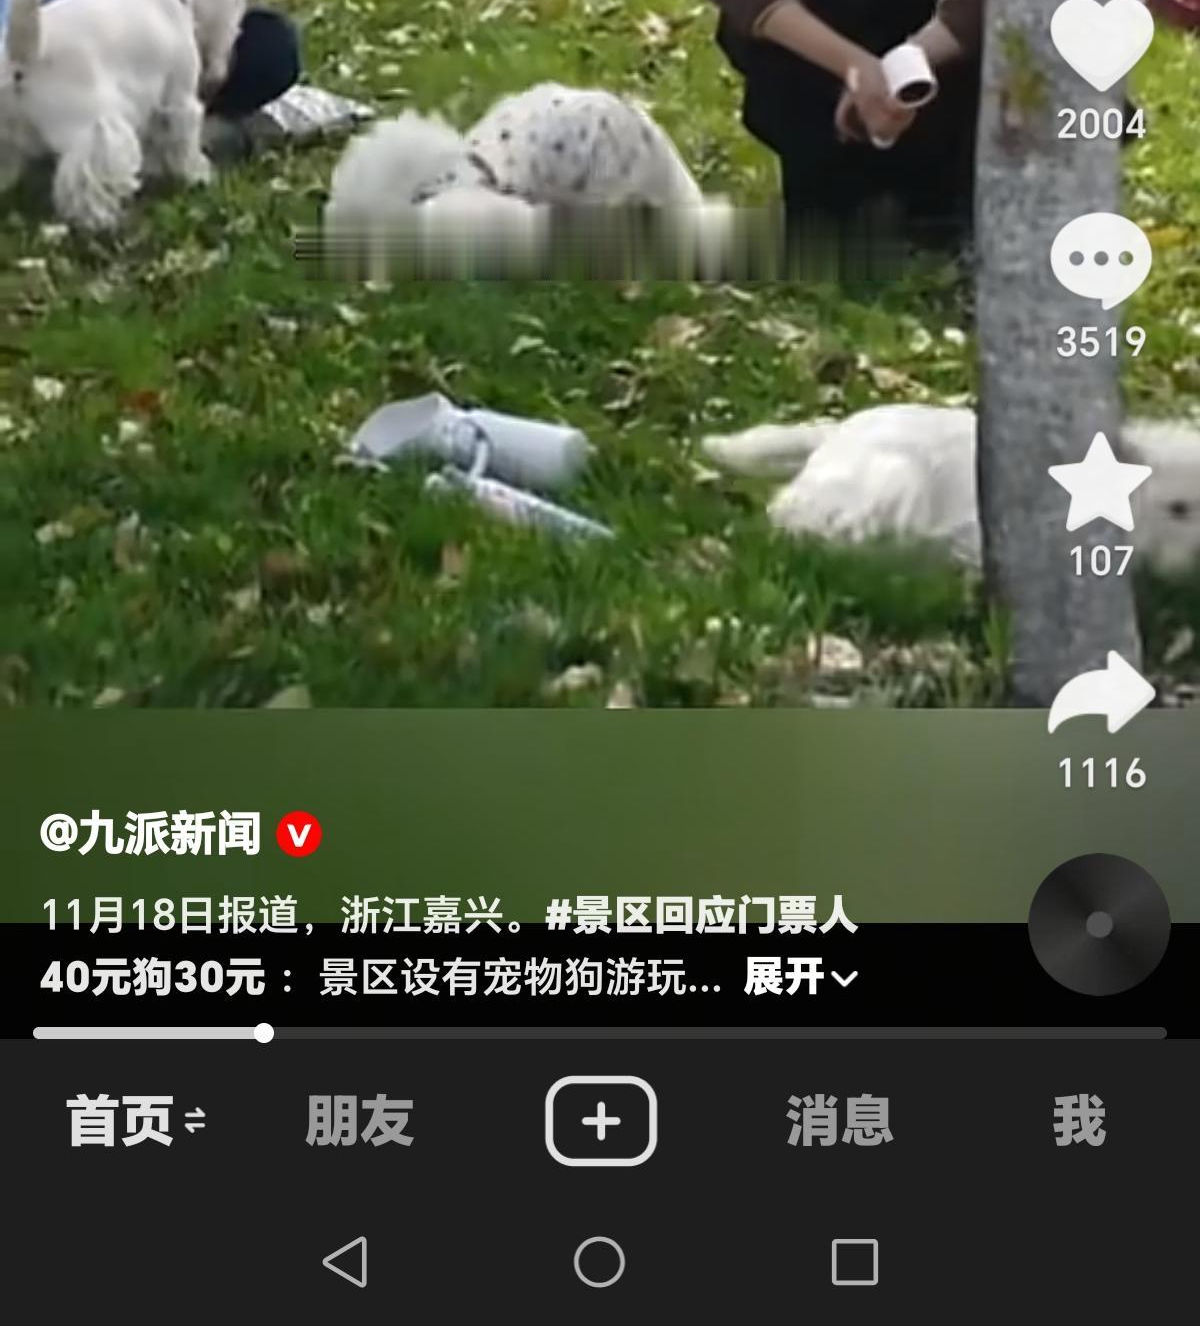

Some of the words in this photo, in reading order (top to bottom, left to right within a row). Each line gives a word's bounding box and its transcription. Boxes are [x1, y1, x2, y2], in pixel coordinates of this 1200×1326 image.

[1057, 107, 1146, 139] 2004
[1056, 326, 1146, 357] 3519
[1070, 546, 1134, 576] 107
[1059, 757, 1147, 788] 1116
[40, 809, 260, 856] @九派新闻
[743, 956, 825, 996] 展开
[66, 1093, 174, 1147] 首页
[305, 1093, 414, 1147] 朋友
[785, 1093, 894, 1147] 消息
[1053, 1093, 1107, 1147] 我
